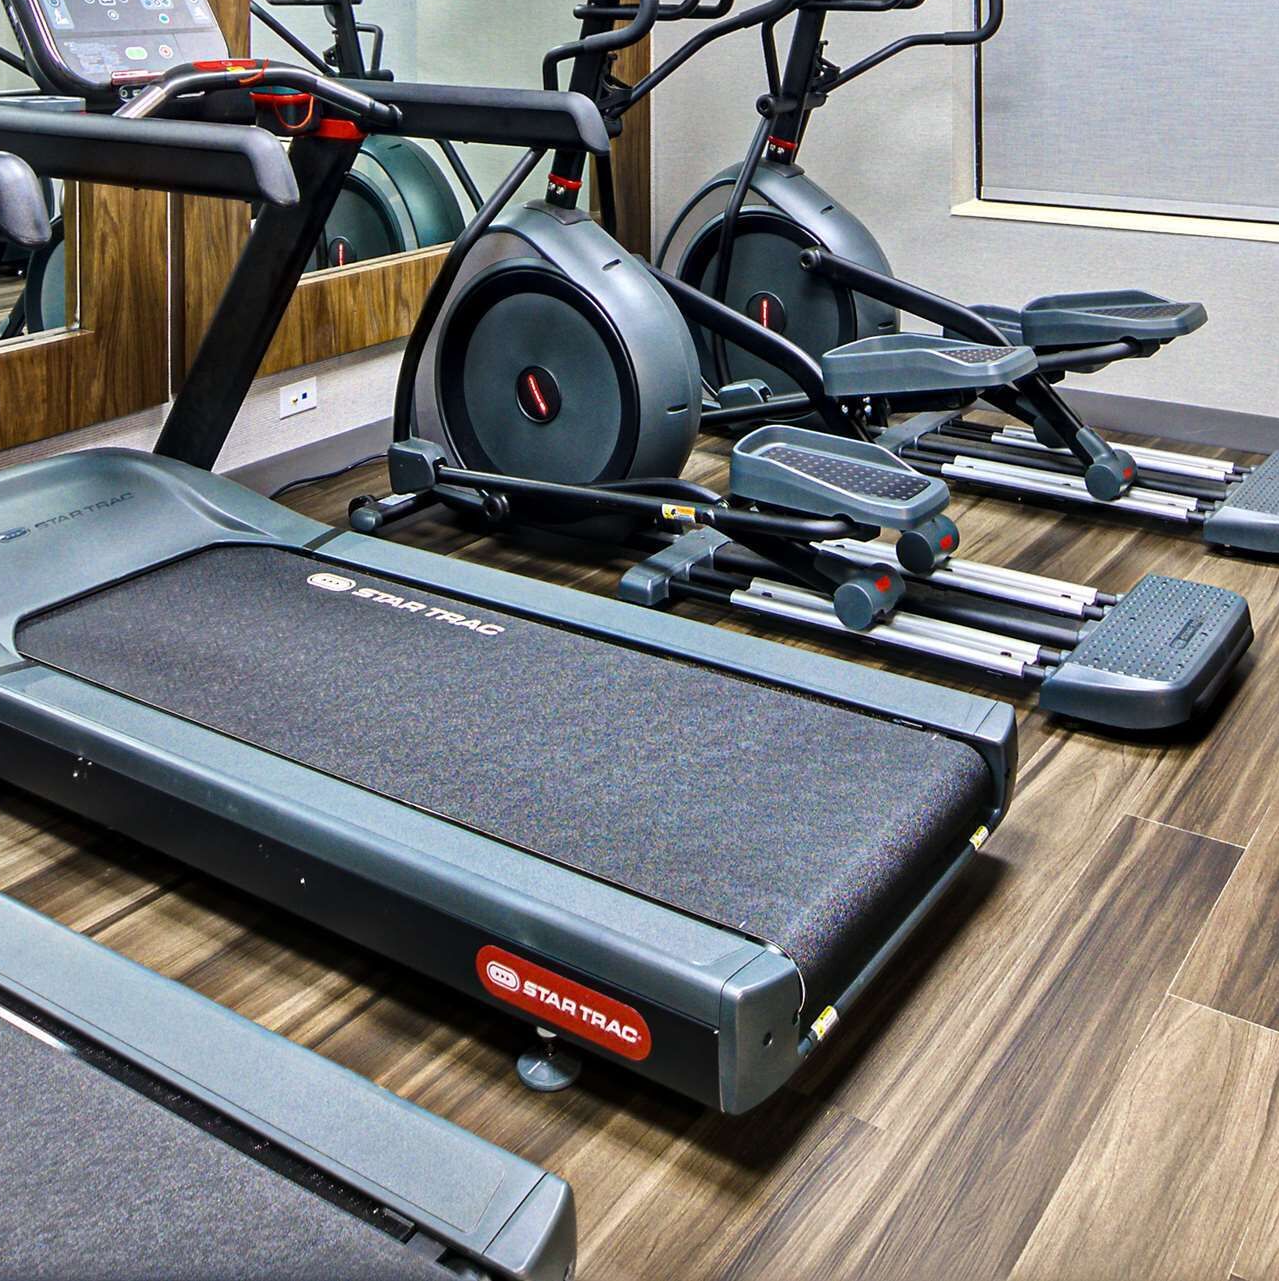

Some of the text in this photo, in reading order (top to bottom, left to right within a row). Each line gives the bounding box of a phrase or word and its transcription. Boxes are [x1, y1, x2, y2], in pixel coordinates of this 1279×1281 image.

[34, 492, 135, 528] STAR TRAC
[351, 587, 506, 636] STAR TRAC
[522, 980, 639, 1044] STAR TRAC
